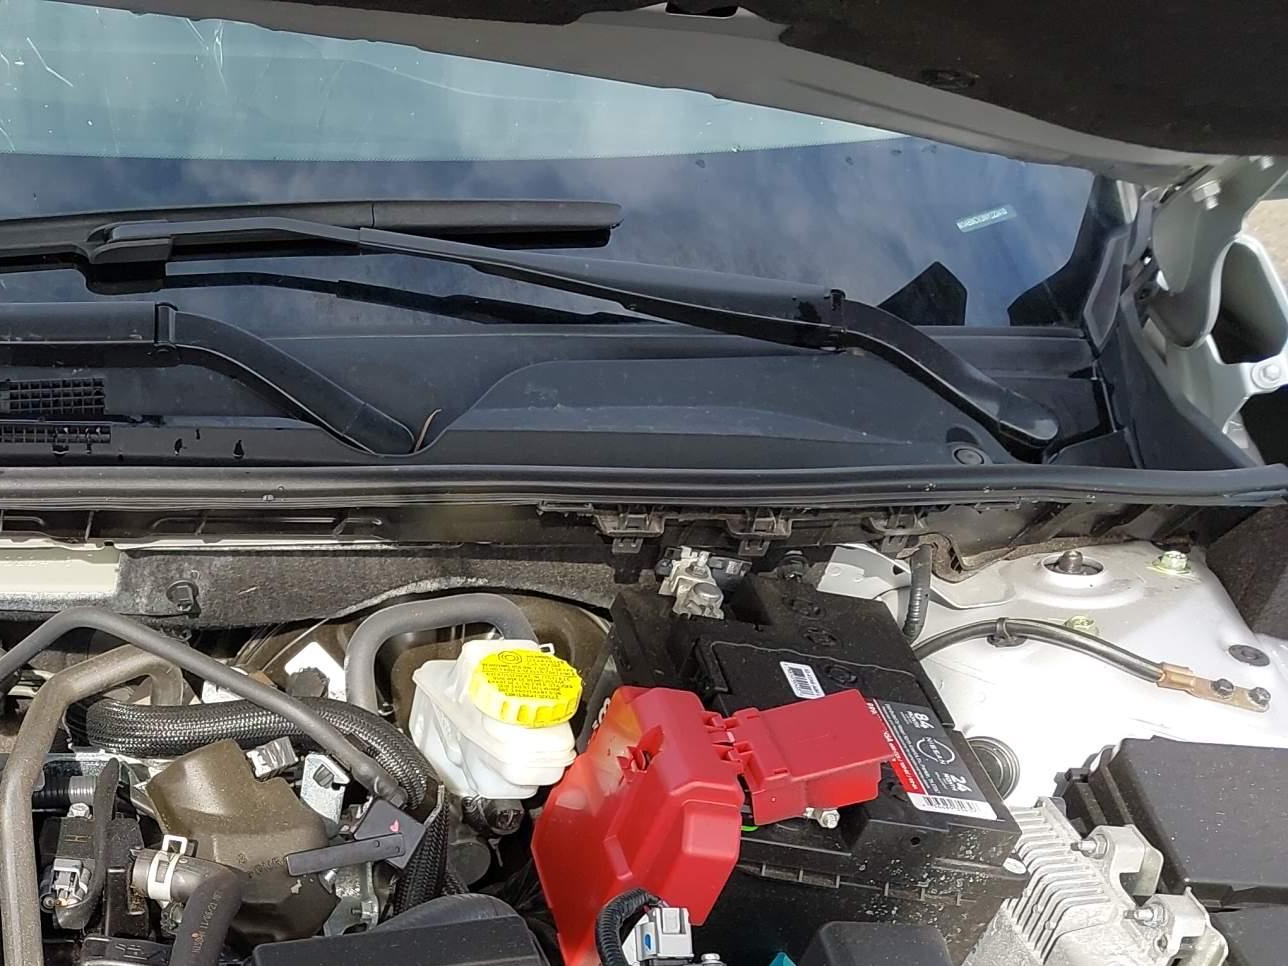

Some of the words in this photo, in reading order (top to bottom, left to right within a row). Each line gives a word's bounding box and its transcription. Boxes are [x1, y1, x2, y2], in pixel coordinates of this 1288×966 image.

[914, 711, 935, 729] 84
[922, 736, 949, 765] NISSAN
[949, 775, 972, 792] 24
